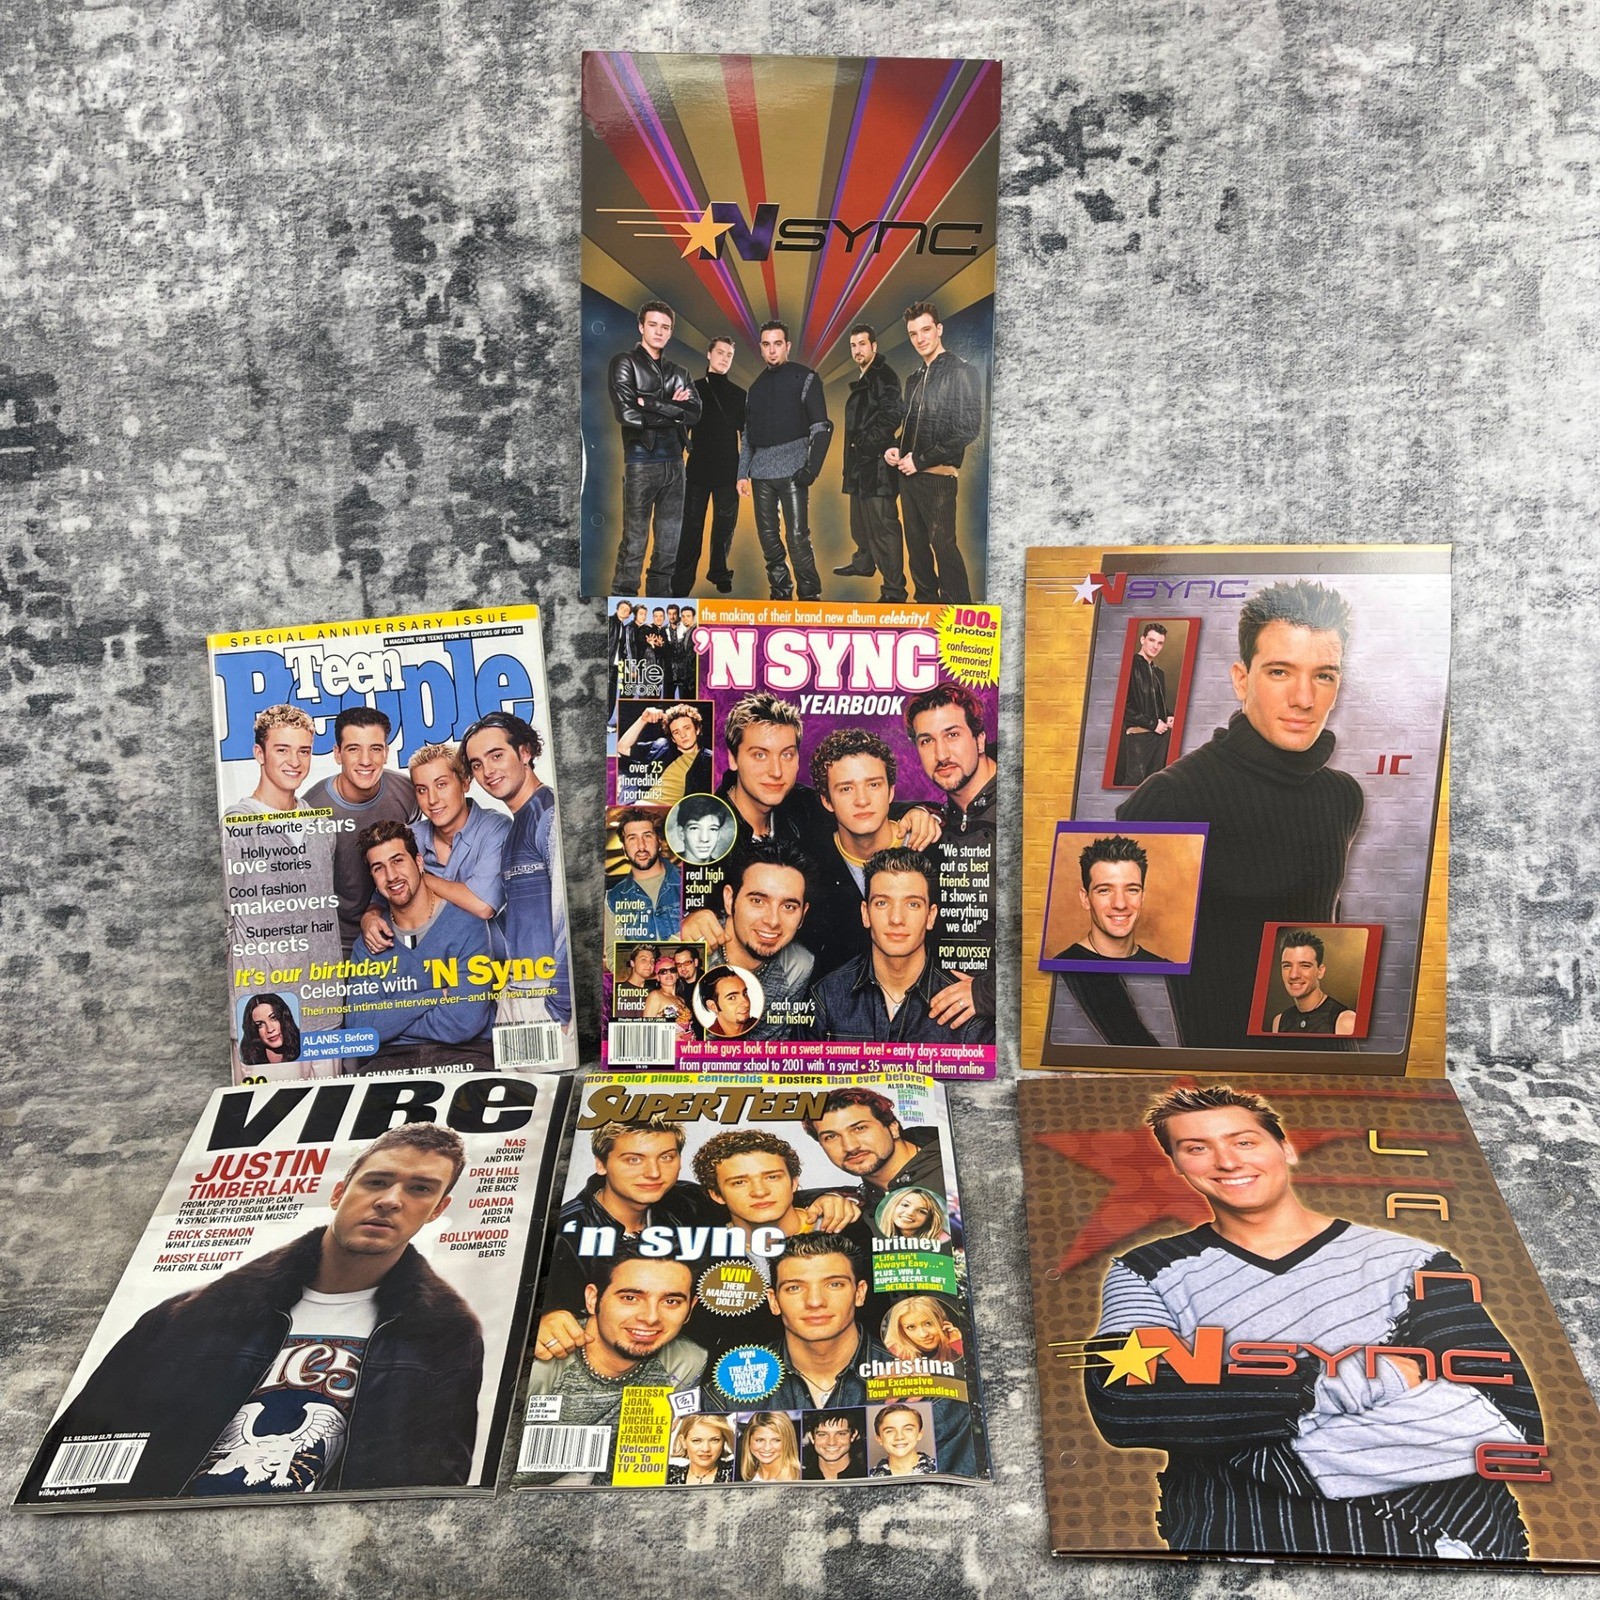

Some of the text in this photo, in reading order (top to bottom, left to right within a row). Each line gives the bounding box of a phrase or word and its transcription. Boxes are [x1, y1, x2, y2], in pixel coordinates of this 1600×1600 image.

[701, 608, 930, 628] the making of their brand new album celebrity!
[230, 632, 306, 648] SPECIAL
[317, 618, 443, 640] ANNIVERSARY
[456, 612, 508, 627] ISSUE
[953, 626, 996, 638] photos!
[946, 641, 994, 656] confessions!
[692, 628, 758, 689] 'N
[764, 629, 938, 693] SYNC
[949, 654, 992, 667] memories!
[283, 644, 405, 699] Teen
[624, 659, 664, 685] life
[961, 668, 990, 680] secrets!
[624, 684, 664, 696] STORY
[800, 695, 905, 715] YEARBOOK
[629, 761, 664, 774] over 25
[1366, 755, 1413, 775] JC
[621, 774, 663, 787] incredible
[623, 789, 662, 802] portraits!
[226, 808, 332, 823] READERS' CHOICE AWARDS
[226, 818, 356, 838] Your favorite stars
[241, 843, 307, 861] Hollywood
[960, 844, 991, 858] started
[227, 858, 312, 875] love stories
[940, 859, 989, 873] out as best
[686, 868, 724, 883] real high
[939, 873, 990, 888] friends and
[229, 883, 307, 899] Cool fashion
[686, 881, 712, 894] school
[686, 894, 705, 908] pics!
[941, 888, 988, 903] it shows in
[230, 894, 340, 917] makeovers
[615, 898, 646, 912] private
[940, 903, 989, 921] everything
[615, 912, 649, 925] party in
[246, 920, 334, 939] Superstar hair
[615, 925, 648, 937] orlando
[946, 923, 960, 932] we
[232, 936, 310, 957] secrets
[939, 946, 991, 958] POP ODYSSEY
[234, 956, 398, 987] It's our birthday!
[941, 958, 988, 972] tour update!
[300, 955, 557, 1000] Celebrate with 'N Sync
[617, 985, 649, 997] famous
[617, 998, 646, 1011] friends
[771, 998, 816, 1014] each guy's
[766, 1012, 816, 1027] hair history
[302, 1033, 374, 1046] ALANIS: Before
[303, 1044, 375, 1057] she was famous
[680, 1041, 985, 1060] what the guys look for in a sweet summer love! early days scrapbook
[584, 1074, 614, 1083] more
[617, 1073, 647, 1083] color
[650, 1073, 693, 1084] pinups,
[697, 1074, 763, 1084] centerfolds
[779, 1075, 823, 1085] posters
[827, 1075, 853, 1084] than
[856, 1074, 882, 1083] ever
[885, 1073, 927, 1085] before!
[504, 1138, 527, 1147] NAS
[495, 1147, 526, 1155] ROUGH
[195, 1148, 332, 1184] JUSTIN
[469, 1166, 520, 1178] DRU HILL
[188, 1177, 322, 1200] TIMBERLAKE
[468, 1197, 515, 1209] UGANDA
[480, 1216, 512, 1225] AFRICA
[167, 1226, 256, 1240] ERICK SERMON
[439, 1229, 510, 1243] BOLLYWOOD
[449, 1240, 507, 1251] BOOMBASTIC
[639, 1225, 787, 1261] sync
[871, 1236, 941, 1253] britney
[156, 1251, 244, 1264] MISSY ELLIOTT
[478, 1249, 506, 1259] BEATS
[720, 1267, 753, 1283] WIN
[705, 1288, 759, 1300] MARIONETTE
[715, 1297, 745, 1307] DOLLS!
[858, 1356, 955, 1378] christina
[625, 1388, 665, 1398] MELISSA
[624, 1398, 652, 1407] JOAN,
[623, 1407, 654, 1416] SARAH
[622, 1416, 669, 1426] MICHELLE,
[621, 1425, 664, 1435] JASON &
[619, 1434, 661, 1444] FRANKIE!
[619, 1444, 666, 1454] Welcome
[618, 1453, 651, 1463] You To
[617, 1463, 664, 1473] TV 2000!
